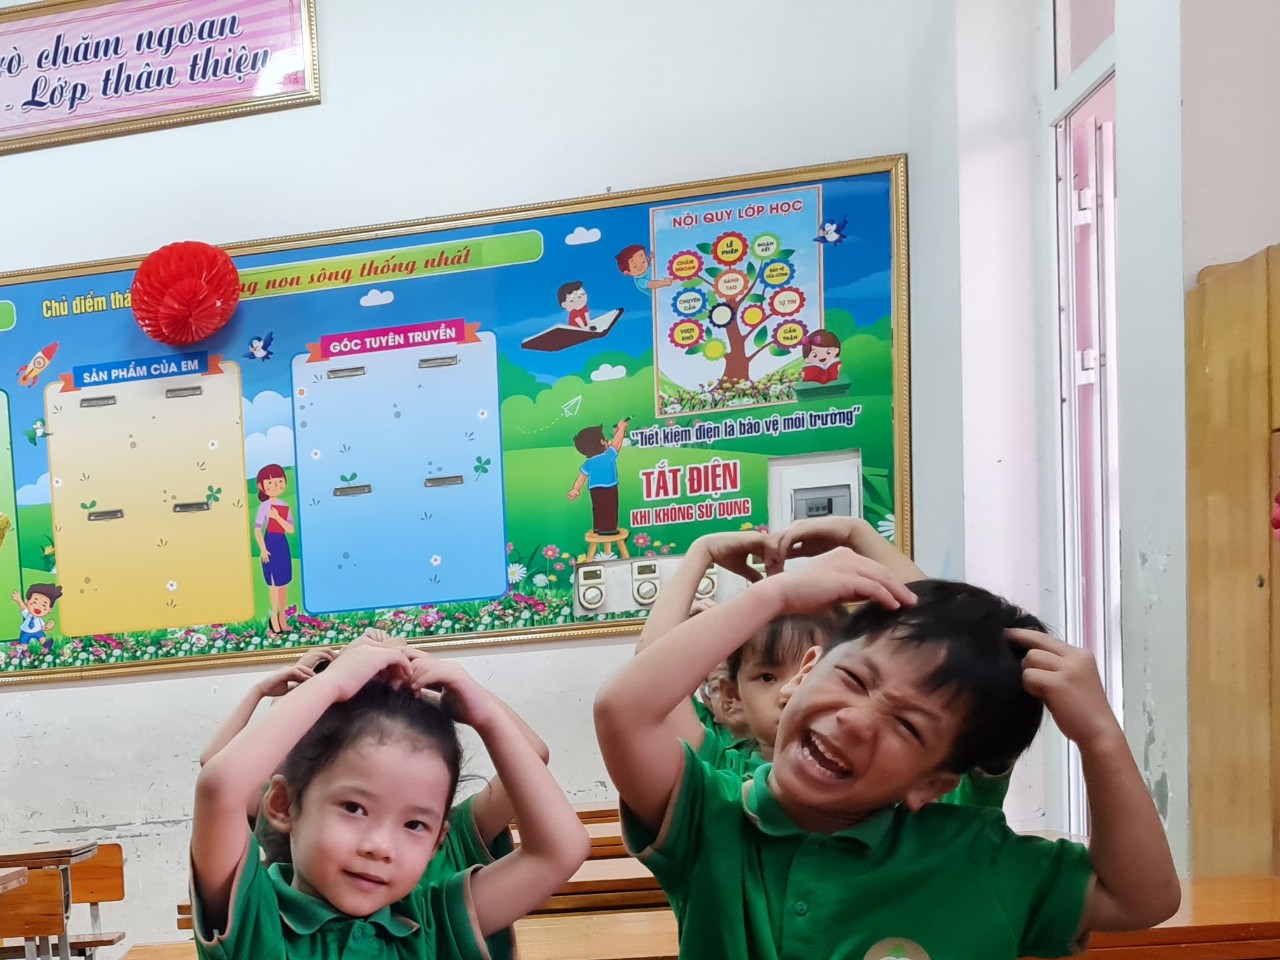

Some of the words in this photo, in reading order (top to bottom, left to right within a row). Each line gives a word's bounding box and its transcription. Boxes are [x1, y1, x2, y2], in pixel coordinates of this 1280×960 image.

[35, 31, 125, 69] chăm
[135, 12, 241, 57] ngoan
[21, 74, 90, 112] Lớp
[101, 61, 179, 98] thân
[188, 45, 271, 84] thiện
[672, 211, 698, 229] NỘI
[703, 209, 732, 225] QUY
[737, 201, 765, 220] LỚP
[769, 199, 803, 217] HỌC
[265, 275, 302, 290] non
[308, 265, 353, 285] sông
[359, 254, 418, 277] thống
[423, 246, 472, 270] nhất
[42, 295, 69, 319] Chủ
[72, 290, 107, 315] điểm
[110, 287, 133, 310] thá
[329, 334, 361, 353] GÓC
[364, 332, 404, 349] TUYÊN
[407, 322, 456, 344] TRUYỀN
[83, 367, 108, 384] SẢN
[111, 361, 147, 381] PHẨM
[150, 359, 178, 376] CỦA
[181, 359, 199, 372] EM
[662, 426, 692, 447] kiệm
[695, 421, 721, 443] điện
[724, 419, 736, 438] là
[738, 415, 761, 436] bảo
[764, 416, 779, 436] vệ
[783, 411, 805, 431] môi
[641, 458, 682, 499] TẮT
[687, 457, 739, 496] ĐIỆN
[631, 510, 652, 527] KHI
[654, 503, 694, 524] KHÔNG
[698, 501, 715, 520] SỬ
[719, 498, 751, 519] DỤNG
